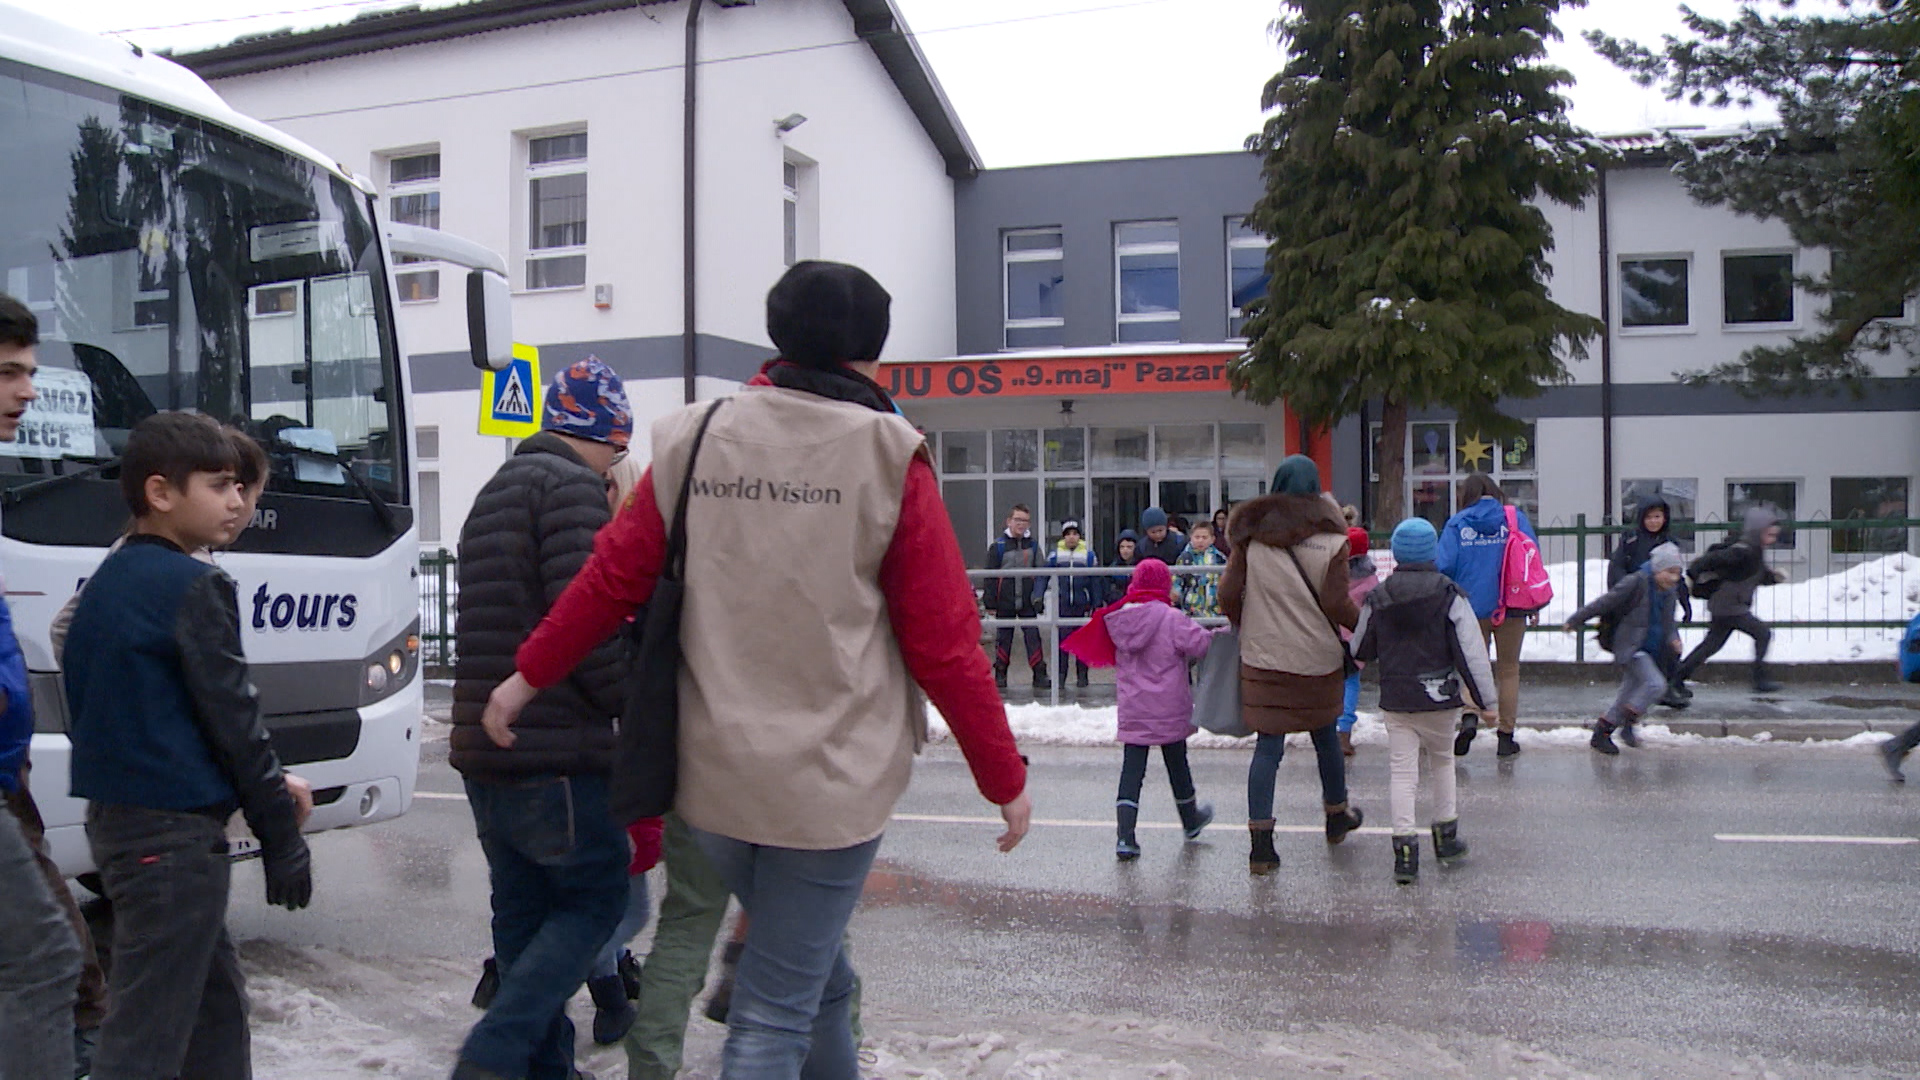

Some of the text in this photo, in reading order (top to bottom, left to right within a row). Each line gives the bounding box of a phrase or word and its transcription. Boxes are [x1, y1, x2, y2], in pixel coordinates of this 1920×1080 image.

[887, 367, 931, 396] JU
[690, 476, 841, 504] World Vision
[250, 509, 278, 529] AR
[252, 582, 358, 631] tours
